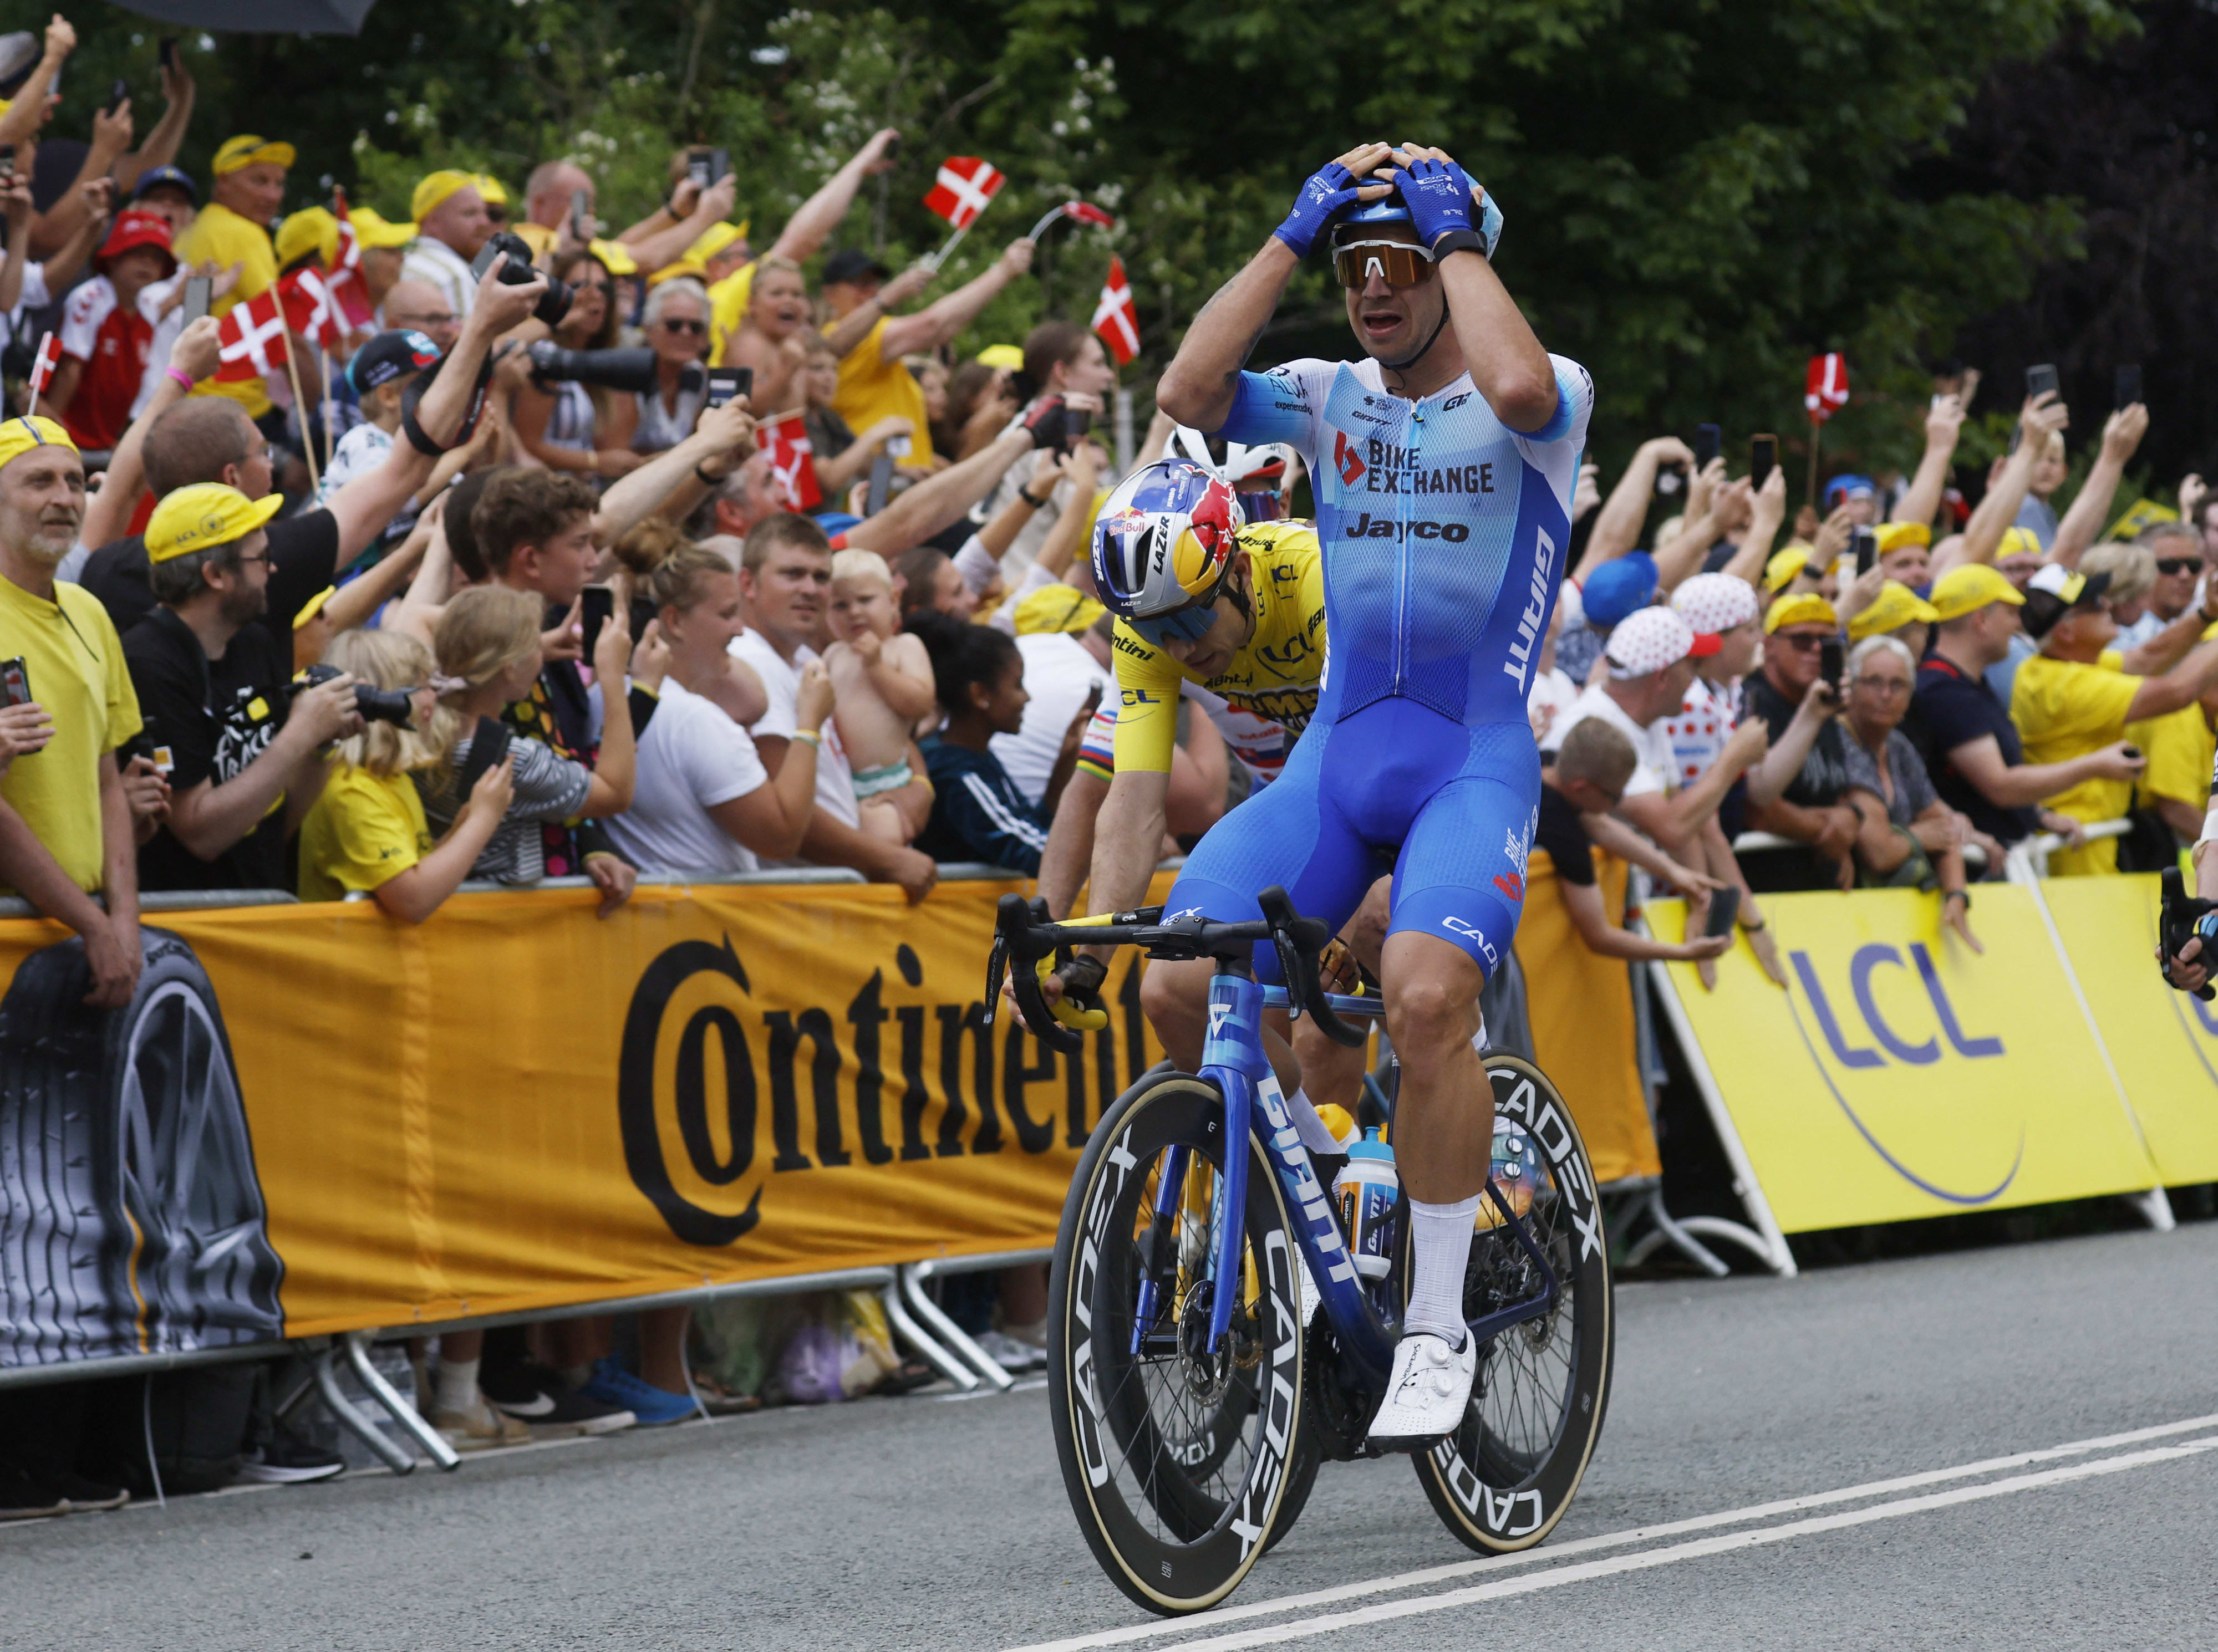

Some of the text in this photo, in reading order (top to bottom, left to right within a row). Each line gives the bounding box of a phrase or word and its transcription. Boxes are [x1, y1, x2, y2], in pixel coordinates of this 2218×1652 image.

[1367, 463, 1494, 494] EXCHANGE
[1369, 439, 1421, 470] BIKE
[1093, 525, 1104, 582] LAZER
[1110, 522, 1145, 537] Red Bull
[1153, 516, 1170, 576] LAZER
[1346, 513, 1469, 543] Jayco
[1256, 585, 1265, 617] LCL
[1503, 524, 1555, 696] GIANT
[1112, 633, 1156, 661] ntini
[1261, 631, 1315, 664] LCL
[1120, 689, 1161, 706] CL
[1504, 826, 1521, 869] BIKE
[1442, 916, 1498, 979] CADE
[1789, 943, 2006, 1069] LCL
[619, 931, 1146, 1246] Continent
[1256, 1075, 1366, 1294] GIANT
[1486, 1068, 1603, 1263] CADEX
[1075, 1123, 1138, 1488] CADEX
[1229, 1229, 1296, 1564] CADEX
[1434, 1436, 1543, 1536] CADE
